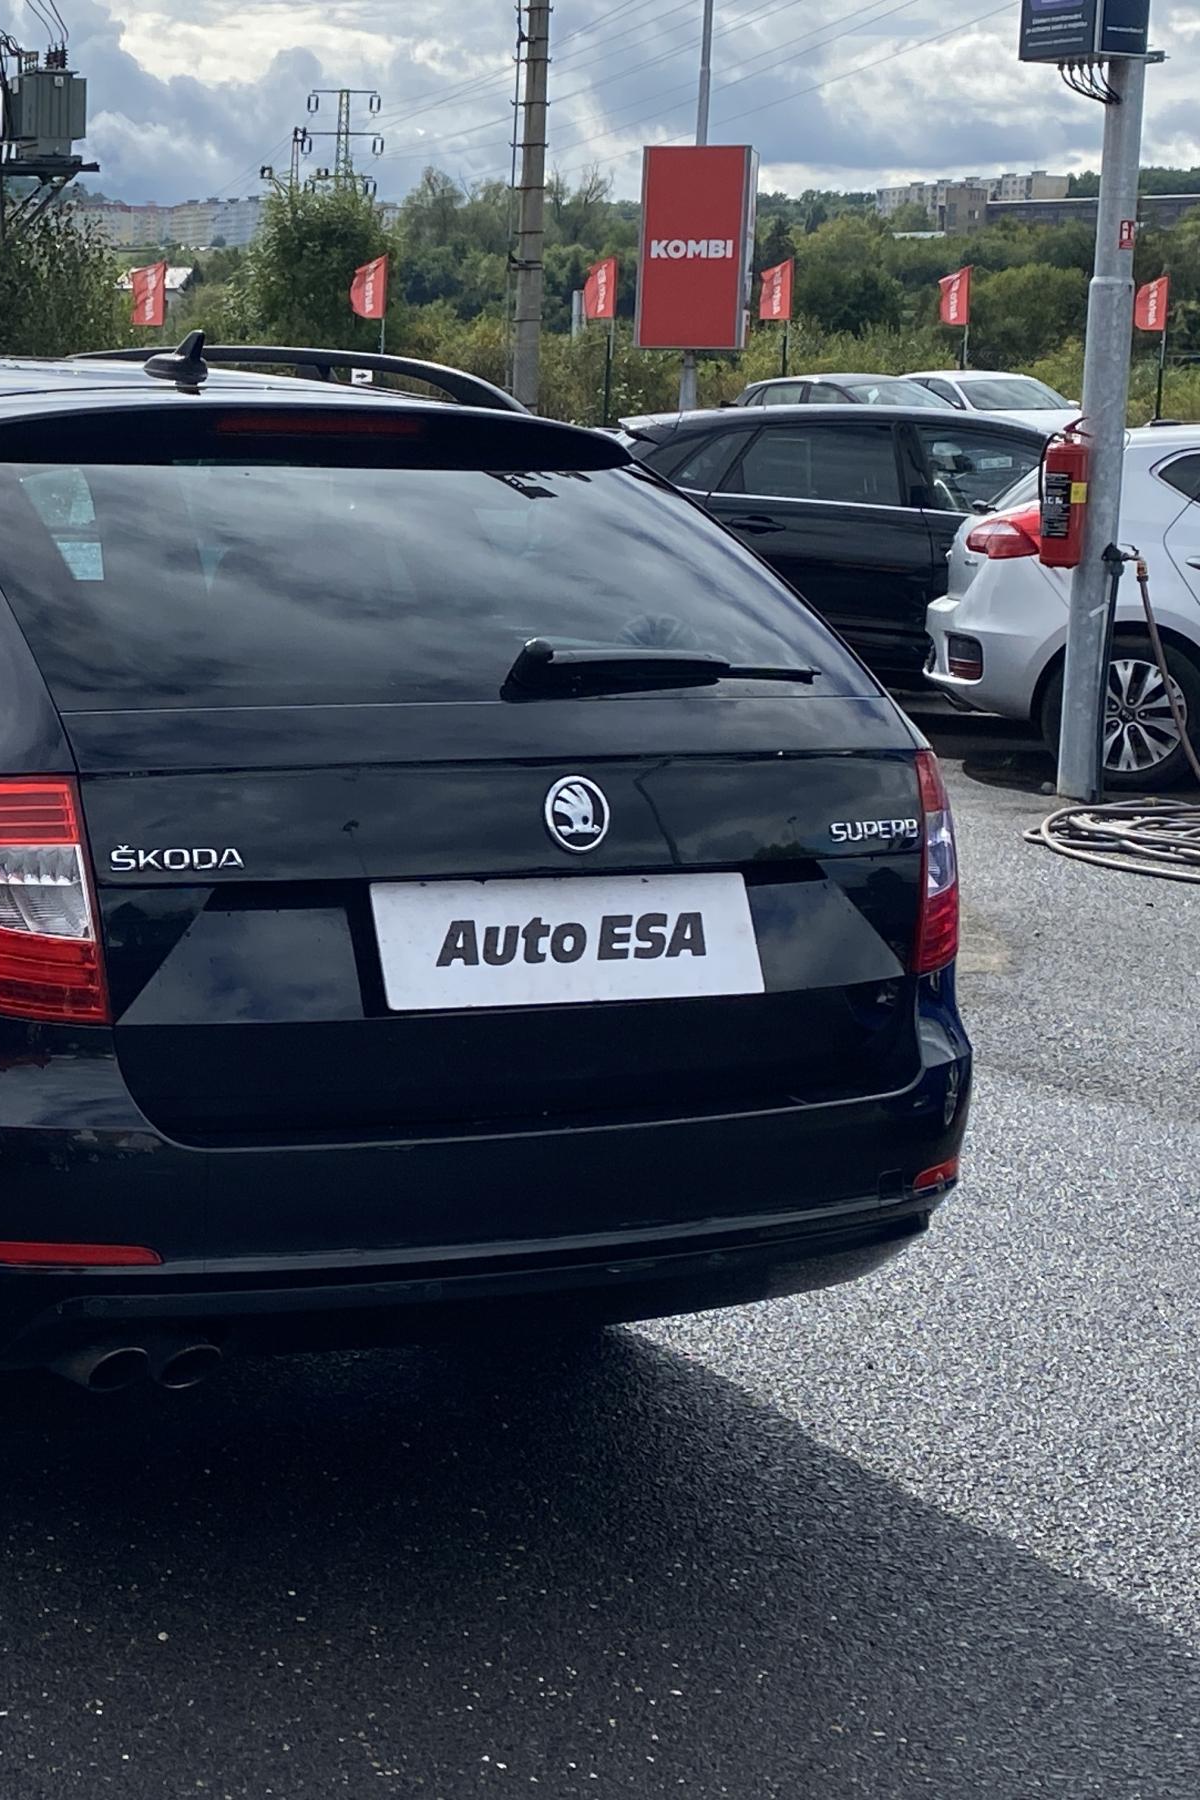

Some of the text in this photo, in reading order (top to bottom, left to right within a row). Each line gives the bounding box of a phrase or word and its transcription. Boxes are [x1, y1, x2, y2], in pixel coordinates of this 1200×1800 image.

[651, 239, 734, 259] KOMBI
[830, 819, 918, 842] SUPERB
[110, 845, 245, 871] ŠKODA
[436, 912, 707, 968] Auto ESA
